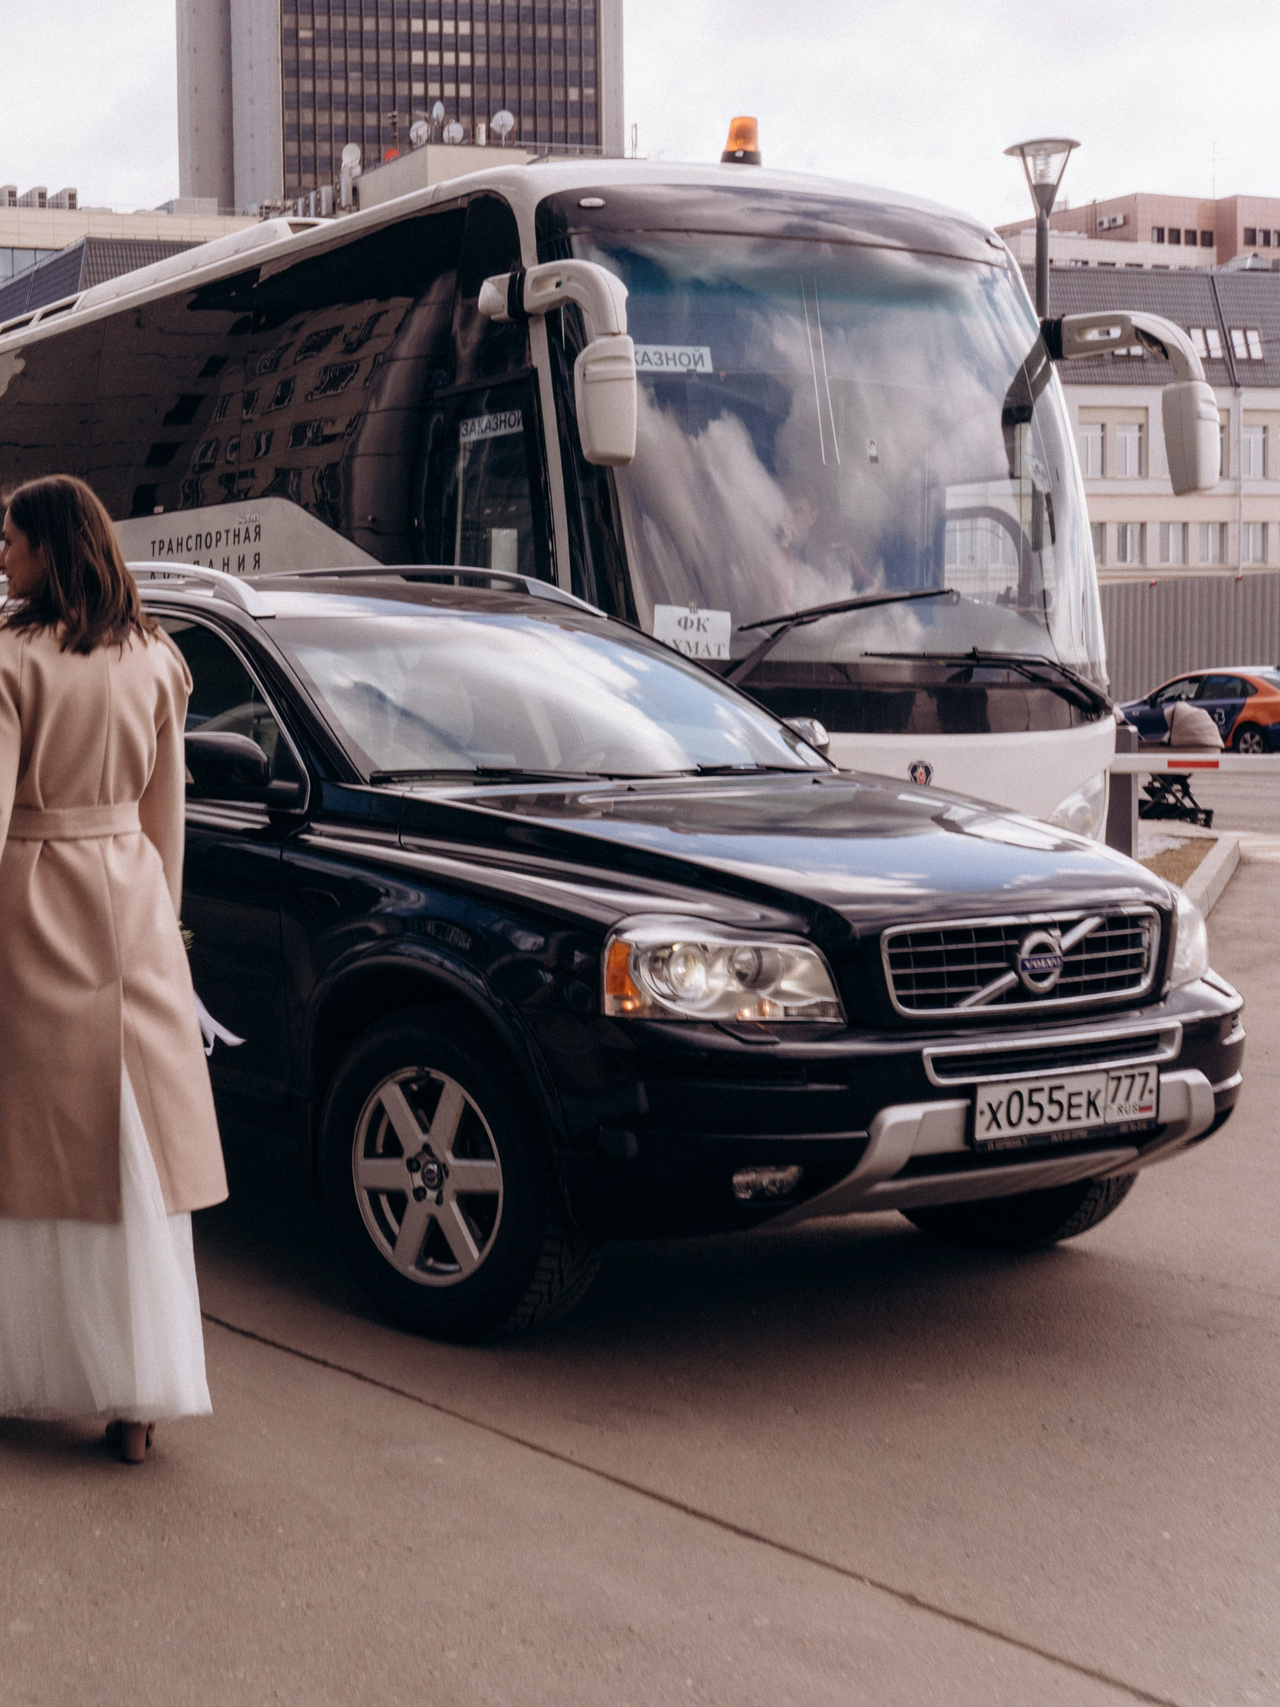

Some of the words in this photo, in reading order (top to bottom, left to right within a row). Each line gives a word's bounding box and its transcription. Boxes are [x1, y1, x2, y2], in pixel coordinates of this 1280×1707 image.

[151, 524, 261, 558] ТРАНСПОРТНАЯ
[677, 616, 710, 633] ФК
[662, 639, 726, 656] ХМАТ
[1109, 1071, 1150, 1104] 777
